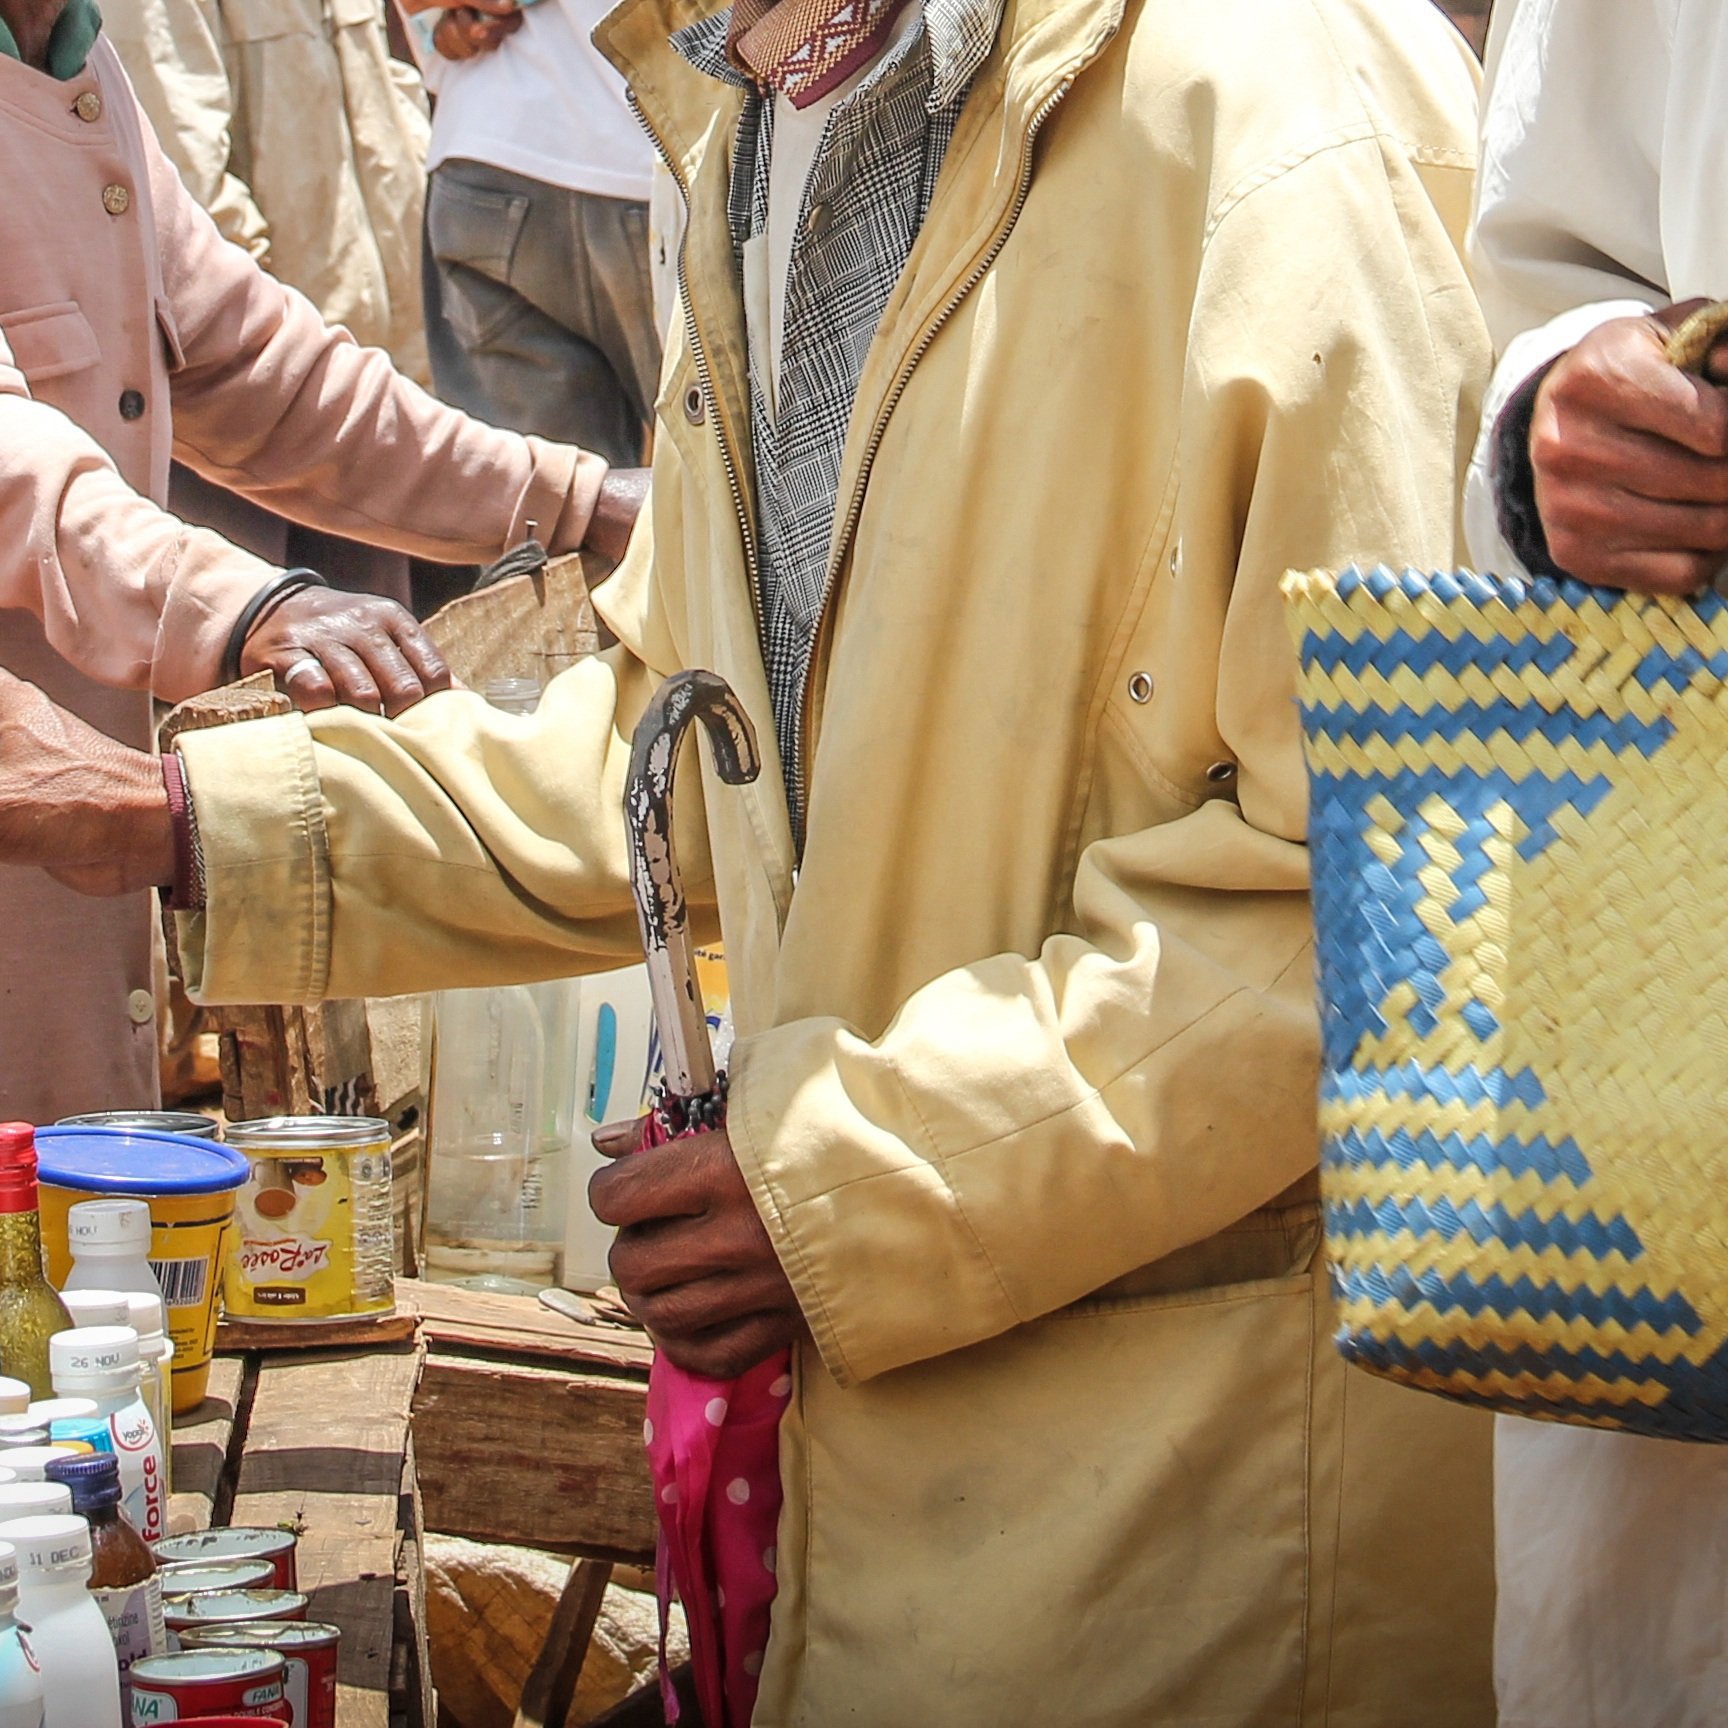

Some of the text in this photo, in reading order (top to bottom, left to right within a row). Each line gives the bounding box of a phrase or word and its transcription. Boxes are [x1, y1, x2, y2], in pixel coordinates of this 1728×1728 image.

[71, 1356, 88, 1369] 26
[141, 1455, 161, 1543] force
[50, 1545, 80, 1564] DEC
